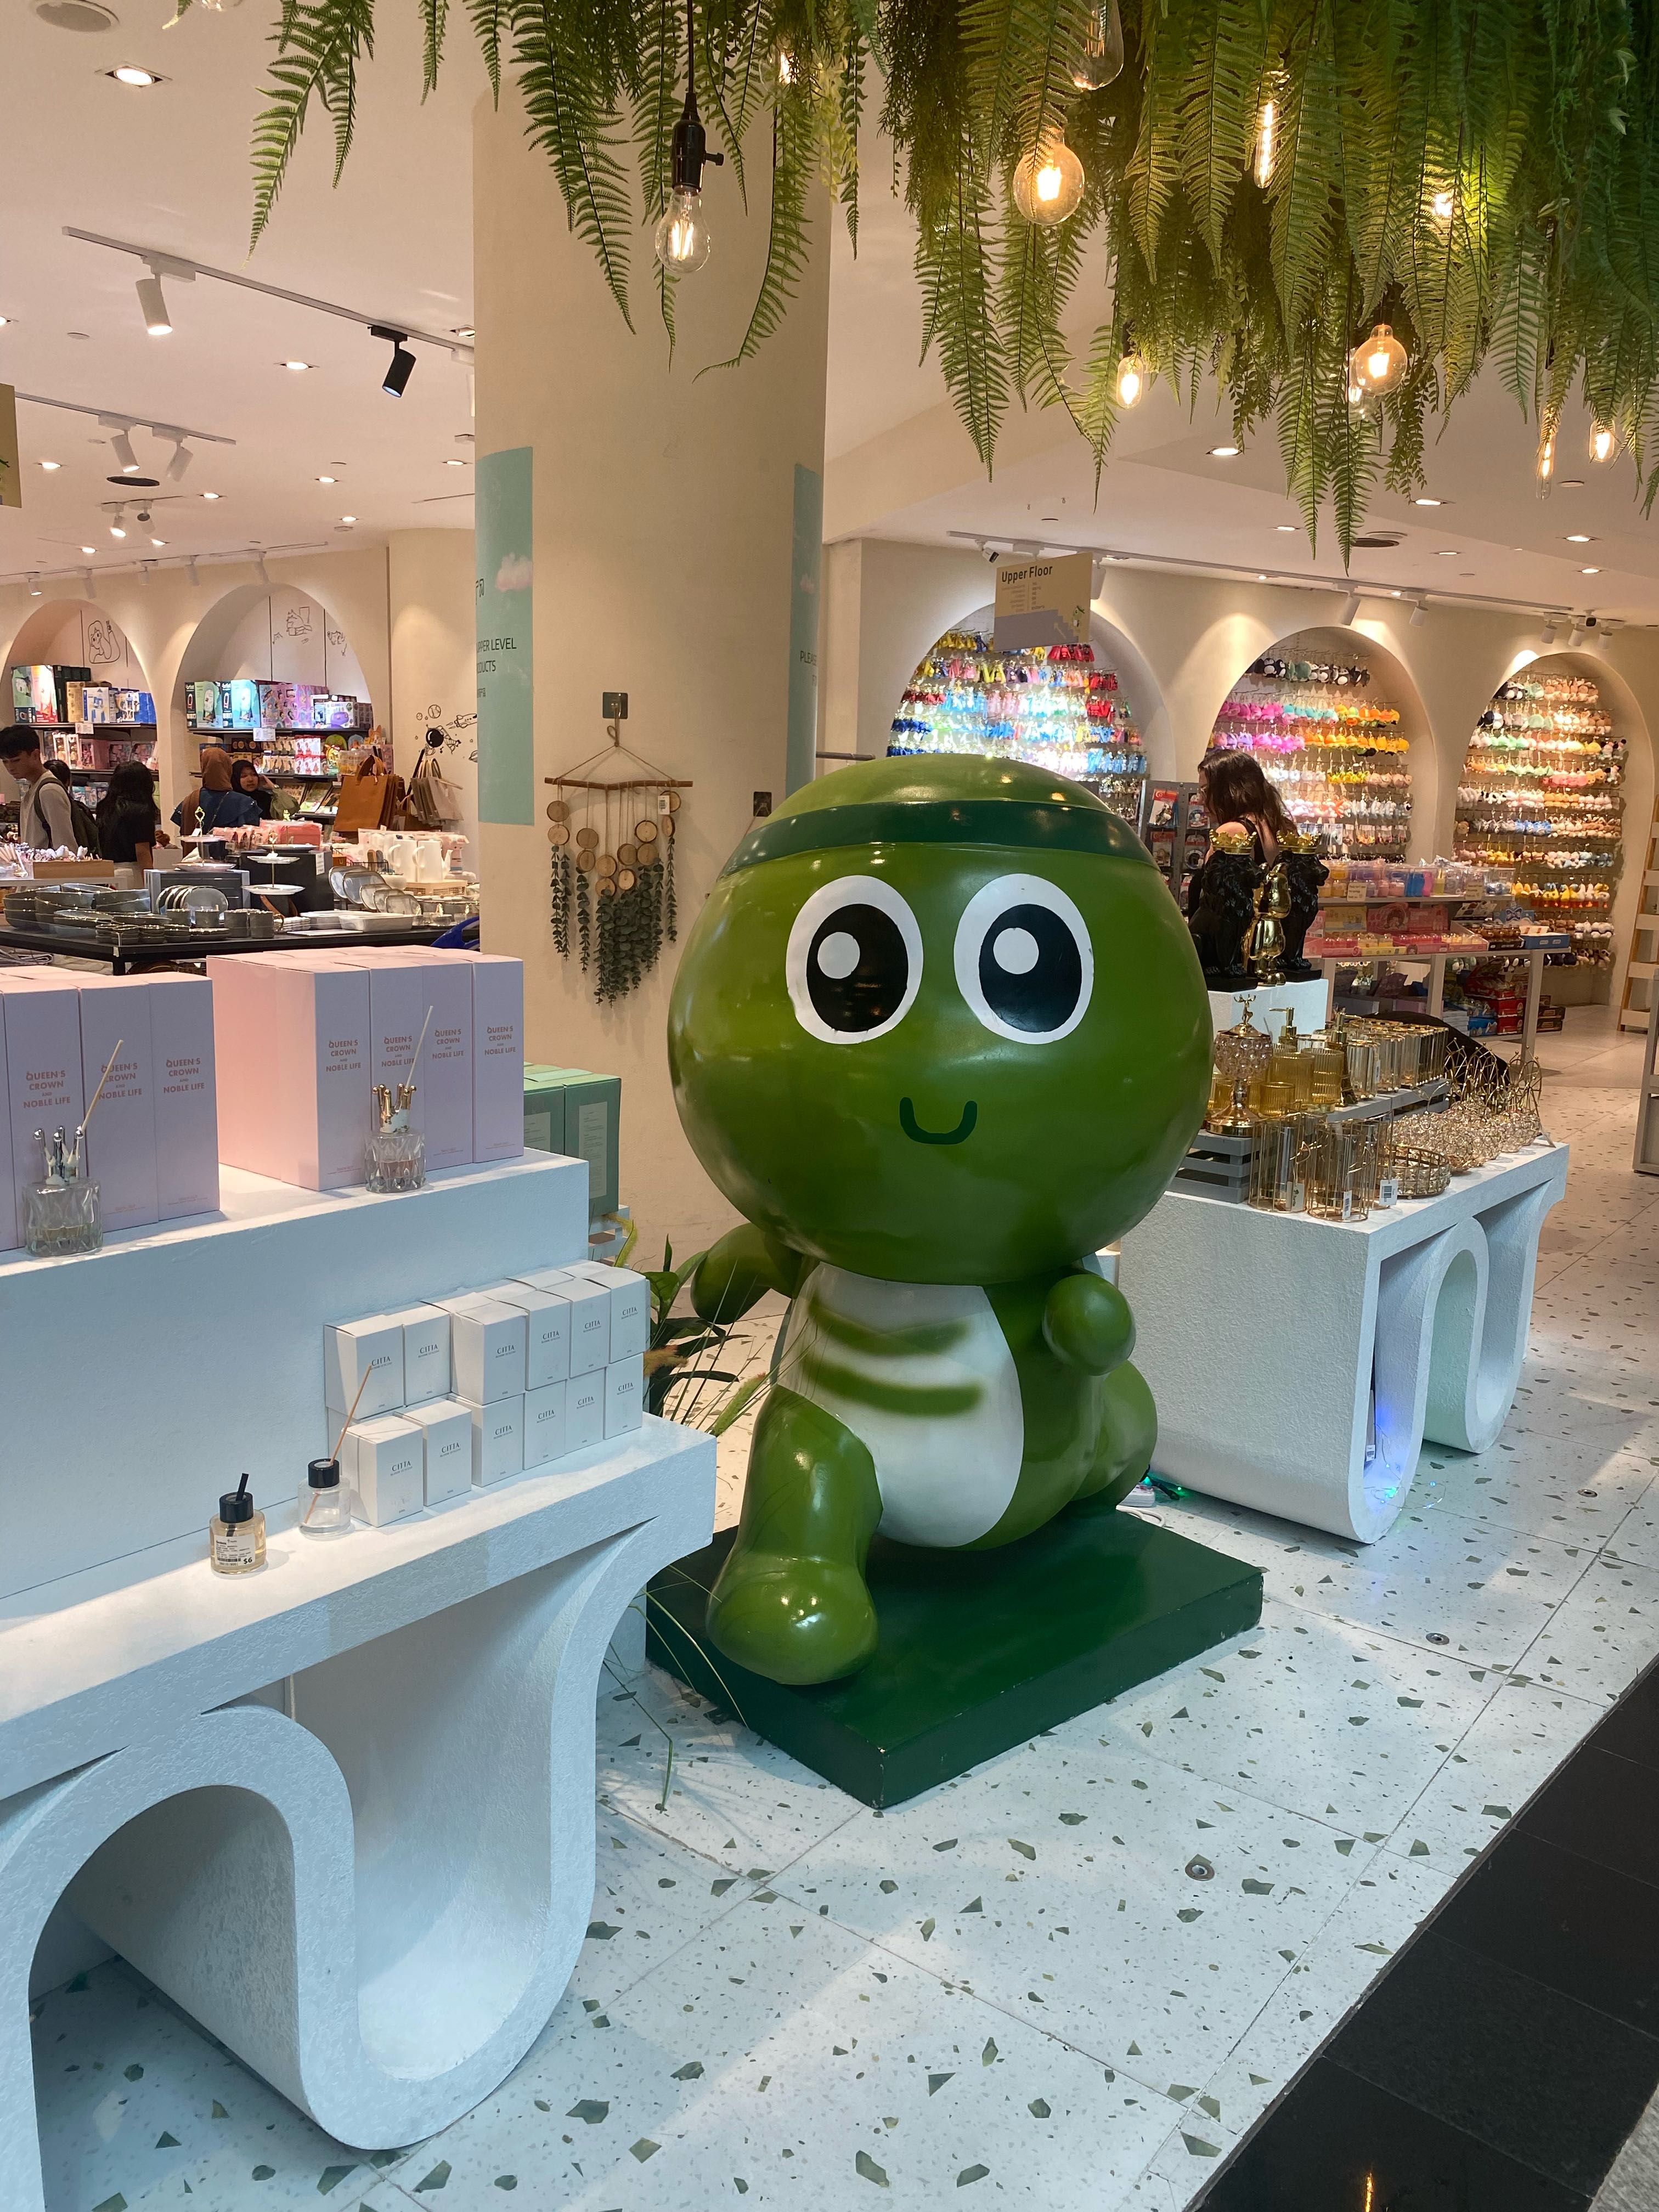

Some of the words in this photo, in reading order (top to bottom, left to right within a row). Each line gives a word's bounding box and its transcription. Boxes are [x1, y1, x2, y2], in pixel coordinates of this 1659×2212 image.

[1002, 570, 1027, 584] Upper
[1029, 565, 1053, 578] Floor
[491, 637, 517, 651] LEVEL
[435, 1029, 461, 1037] QUEEN'S
[487, 1025, 513, 1034] QUEEN'S
[329, 1039, 358, 1048] QUEEN'S
[383, 1036, 413, 1045] QUEEN'S
[330, 1048, 357, 1057] CROWN
[166, 1058, 201, 1068] QUEEN'S
[326, 1064, 348, 1072] NOBLE
[381, 1059, 402, 1068] NOBLE
[26, 1070, 66, 1081] QUEEN'S
[168, 1068, 199, 1077] CROWN
[29, 1080, 64, 1091] CROWN
[163, 1084, 189, 1093] NOBLE
[99, 1090, 126, 1099] NOBLE
[128, 1088, 142, 1096] LIFE
[23, 1098, 53, 1108] NOBLE
[55, 1096, 70, 1105] LIFE
[622, 1306, 637, 1316] CITTA
[584, 1320, 600, 1329] CITTA
[543, 1330, 559, 1340] CITTA
[420, 1344, 438, 1354] CITTA
[497, 1345, 515, 1355] CITTA
[371, 1356, 391, 1366] CITTA
[618, 1382, 633, 1392] CITTA
[578, 1396, 594, 1406] CITTA
[538, 1409, 555, 1419] CITTA
[495, 1425, 512, 1435] CITTA
[441, 1442, 460, 1453] CITTA
[392, 1460, 411, 1471] CITTA
